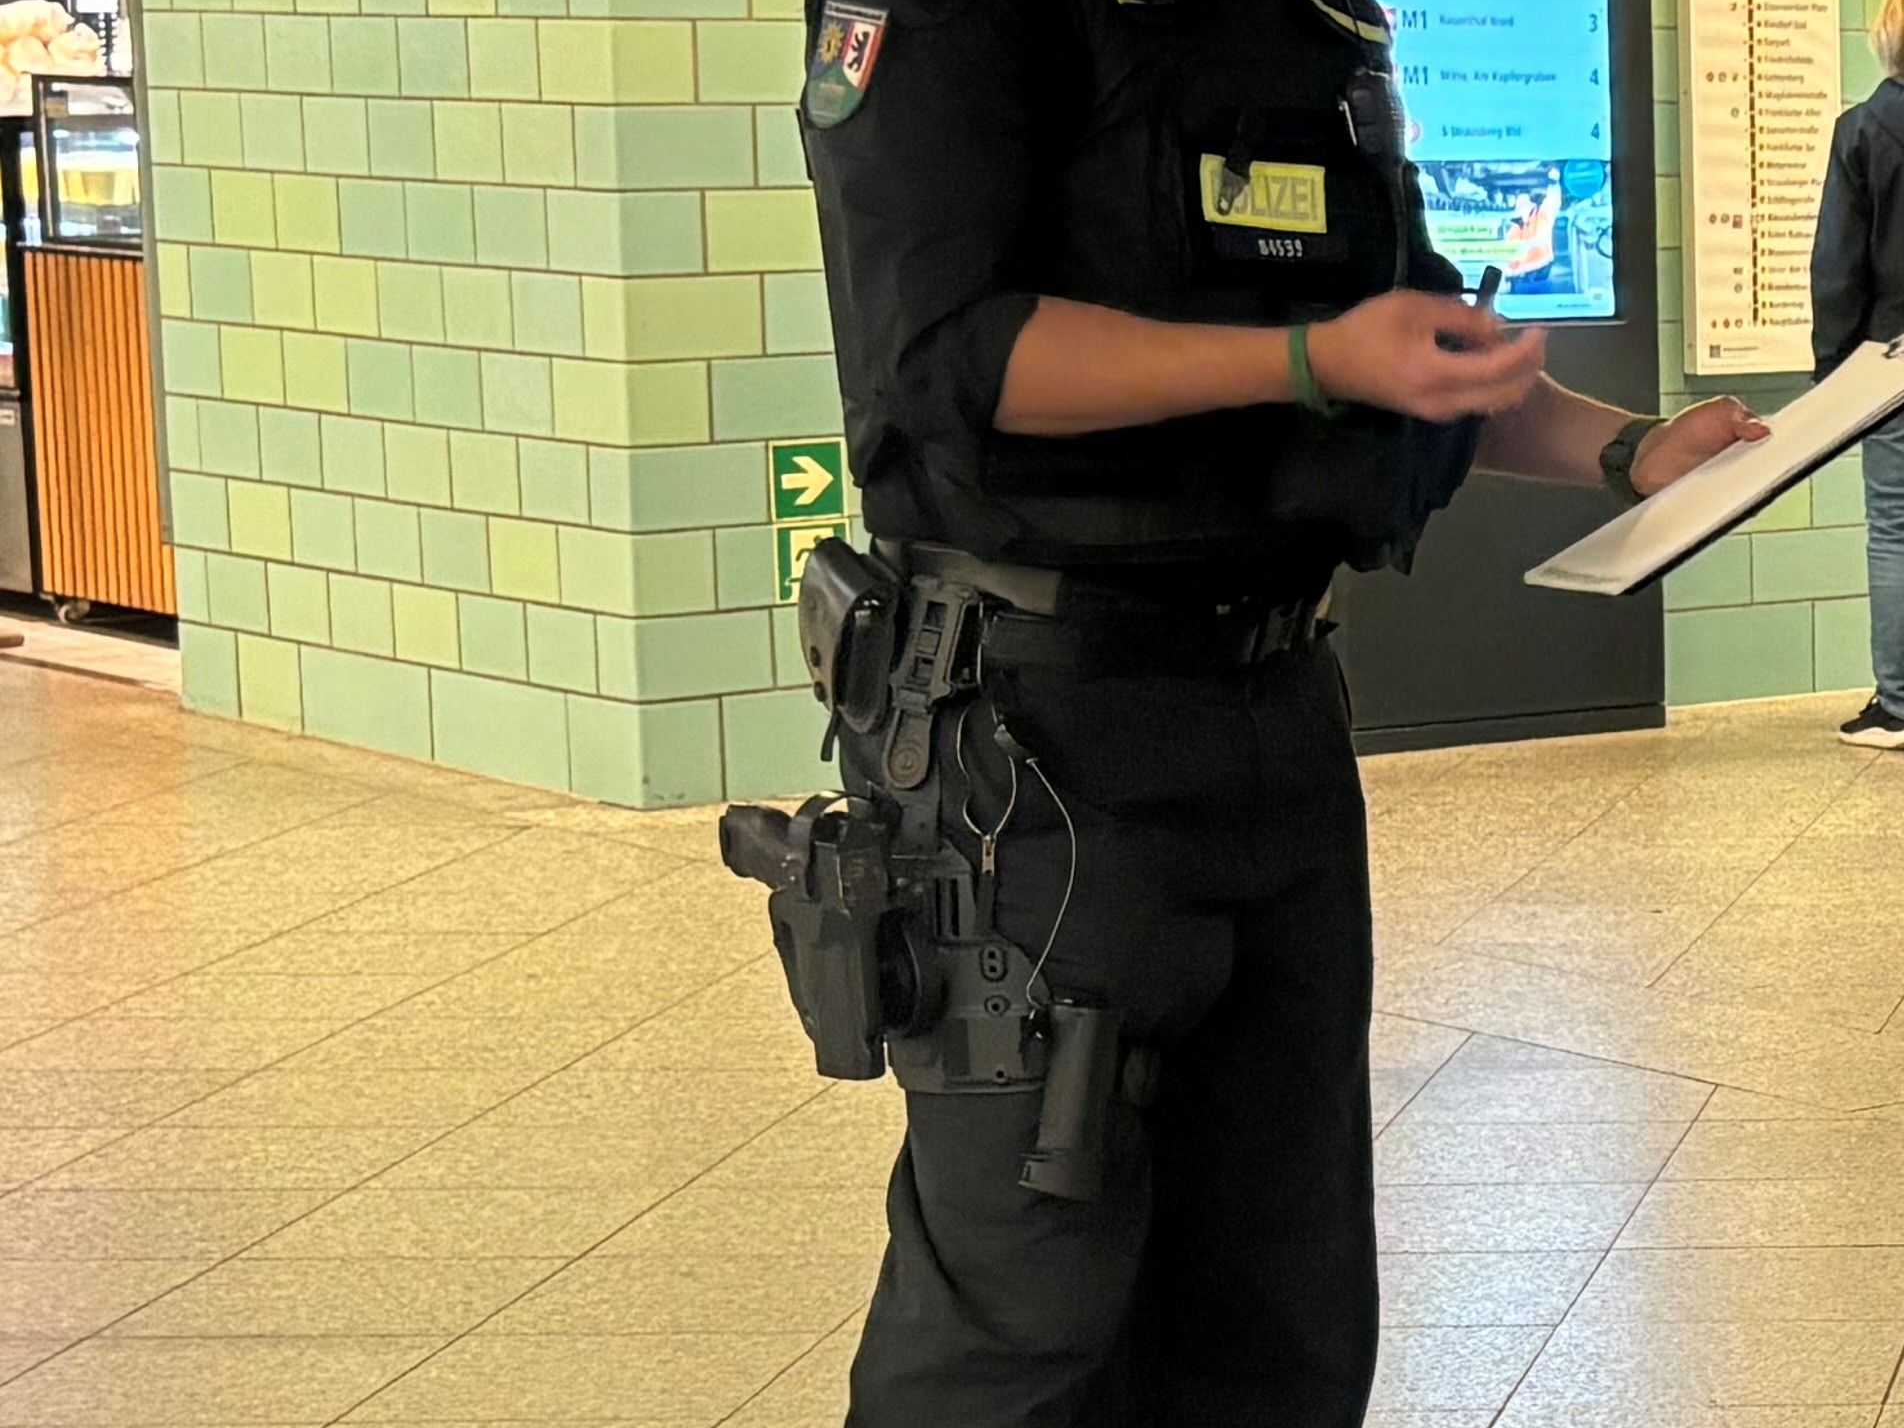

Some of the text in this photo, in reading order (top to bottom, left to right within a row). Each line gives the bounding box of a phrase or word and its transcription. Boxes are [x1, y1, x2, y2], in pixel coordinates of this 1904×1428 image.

[1402, 10, 1428, 29] M1
[1588, 13, 1598, 33] 3
[1403, 66, 1429, 85] M1
[1589, 68, 1599, 85] 4
[1590, 123, 1600, 140] 4
[1210, 169, 1318, 221] LIZEI
